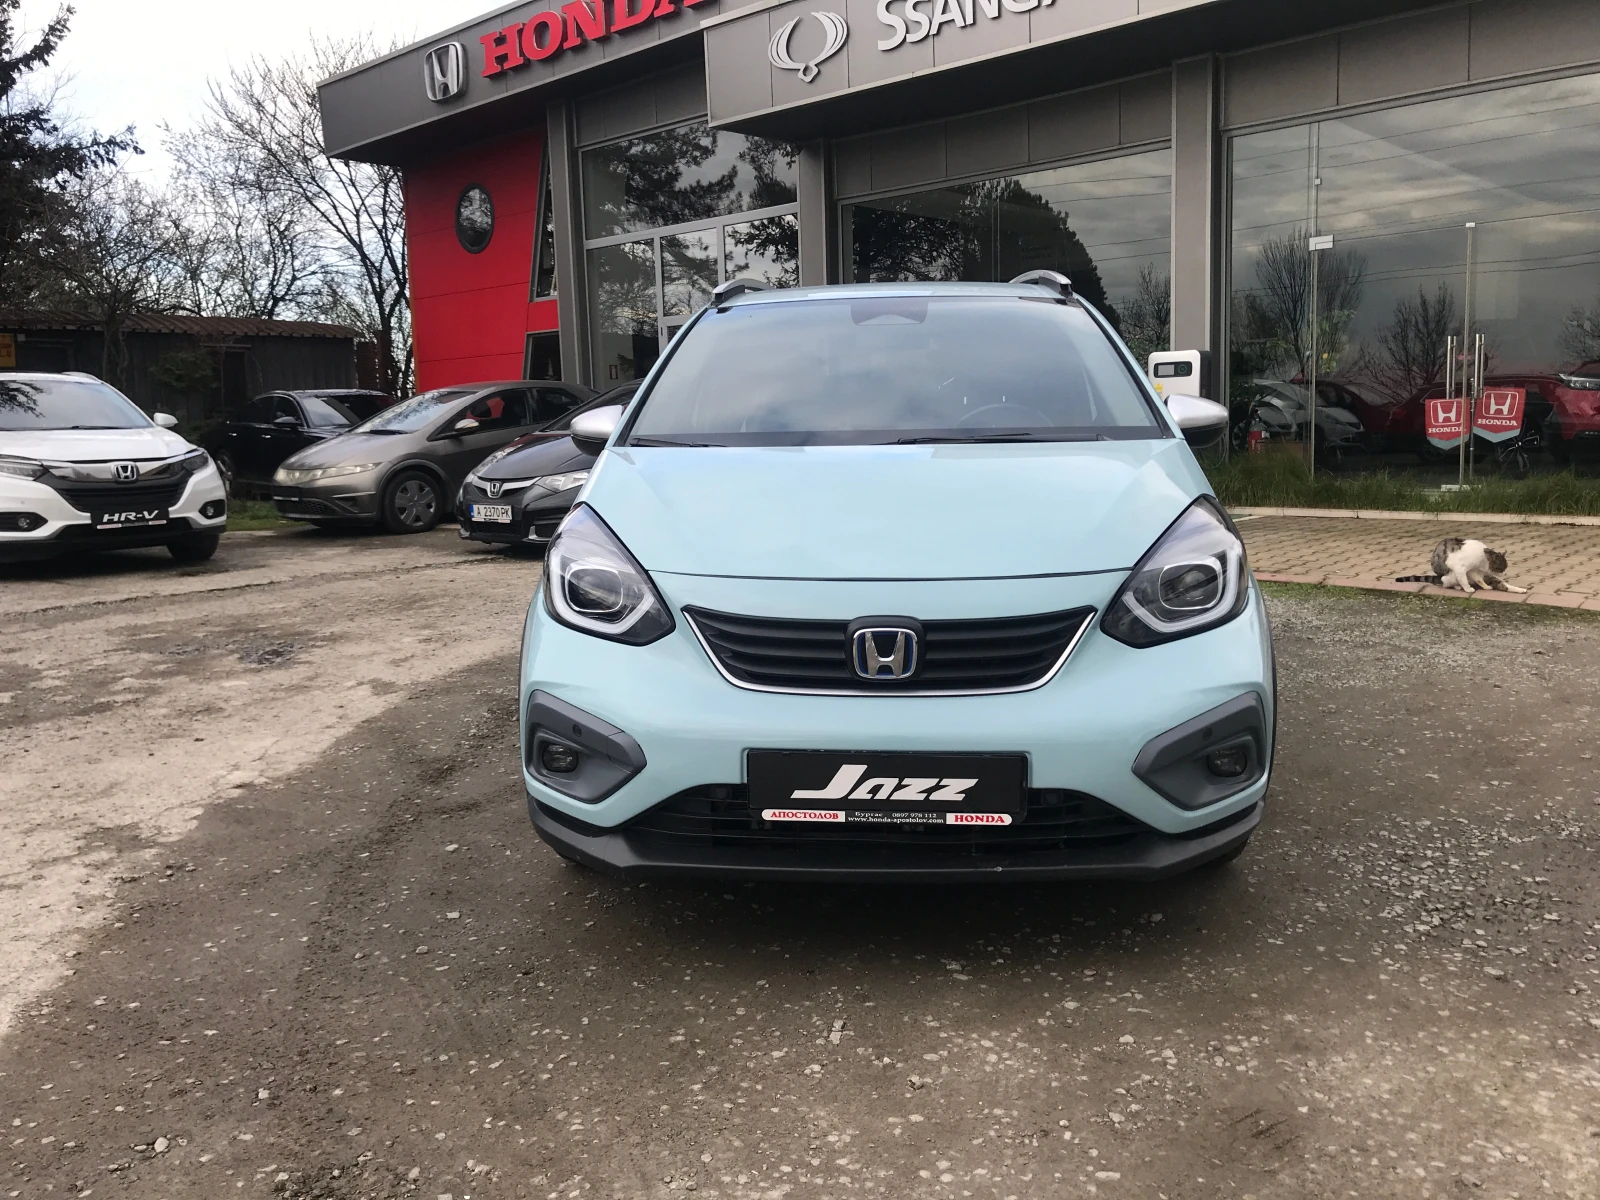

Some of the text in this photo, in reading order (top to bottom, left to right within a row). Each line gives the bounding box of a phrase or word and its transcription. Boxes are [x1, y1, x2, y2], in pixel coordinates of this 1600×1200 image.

[1477, 418, 1518, 426] HONDA
[102, 510, 160, 523] HR-V
[847, 816, 944, 824] www.honda-apostolov.com
[954, 814, 1006, 824] HONDA
